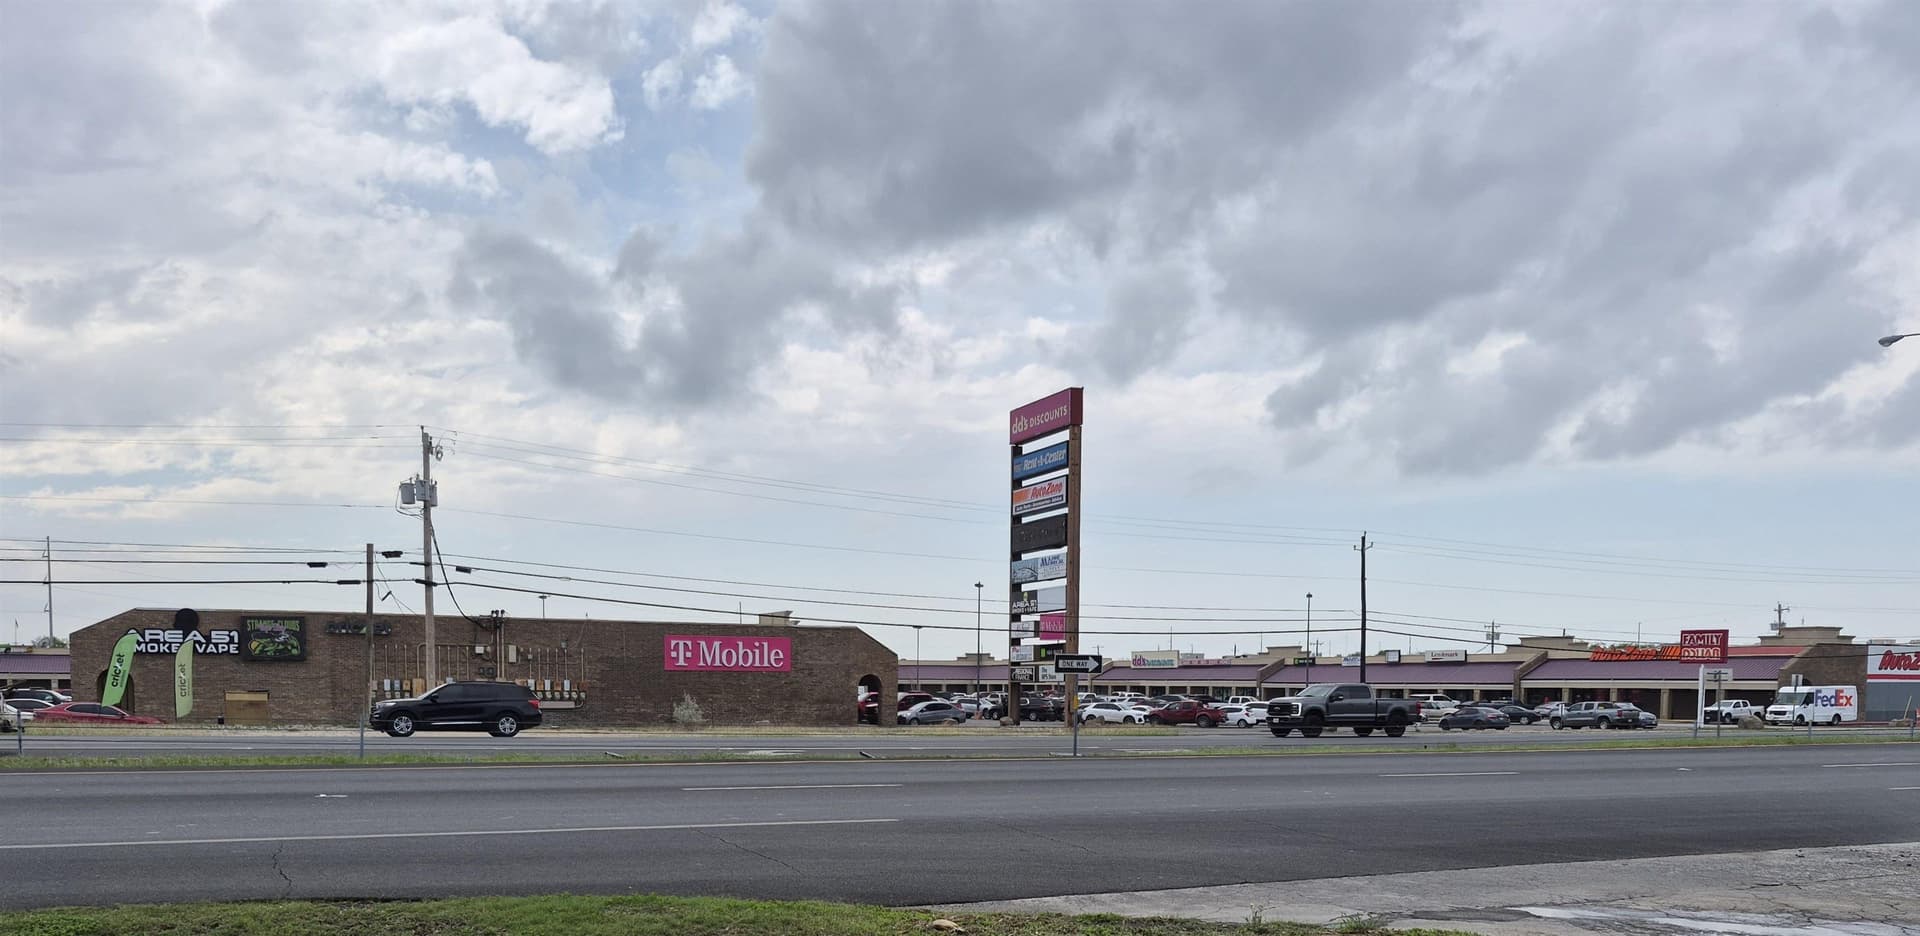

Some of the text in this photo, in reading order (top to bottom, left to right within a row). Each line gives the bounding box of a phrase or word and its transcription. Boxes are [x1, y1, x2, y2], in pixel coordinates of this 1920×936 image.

[1012, 405, 1068, 434] dd's DISCOUNTS
[1031, 481, 1063, 499] AutoZone
[127, 628, 239, 643] AREA 51
[1682, 633, 1722, 646] FAMILY
[134, 643, 239, 654] MOKE VAPE
[697, 640, 784, 668] Mobile
[1878, 649, 1920, 671] AutoZ
[111, 653, 125, 688] cricket
[178, 663, 186, 698] cricket
[1814, 689, 1853, 707] FedEx
